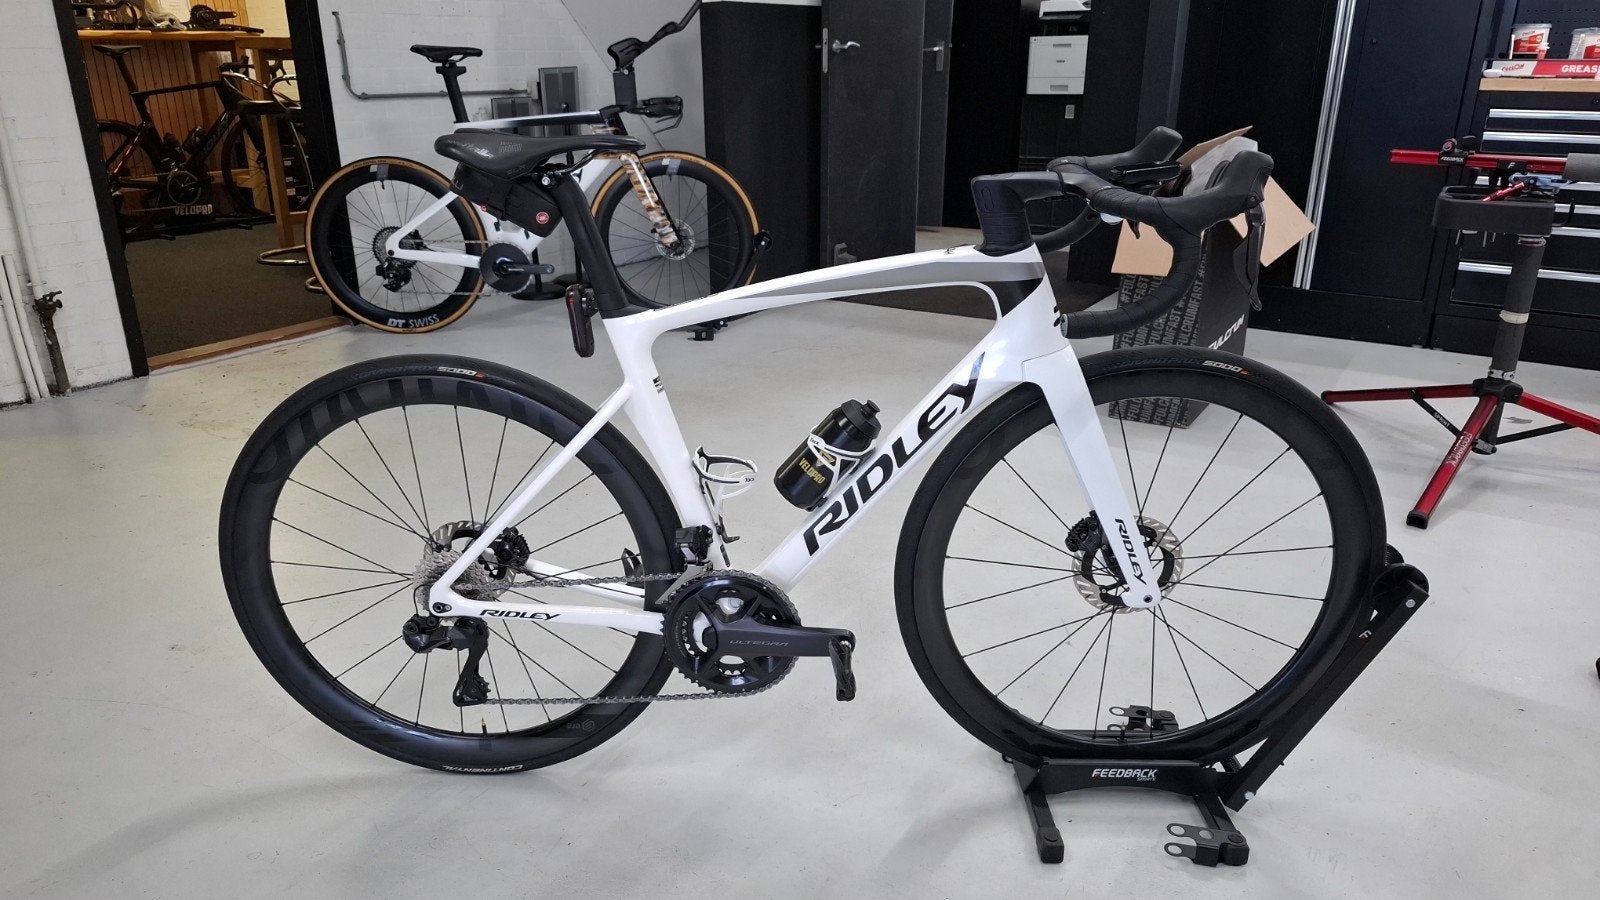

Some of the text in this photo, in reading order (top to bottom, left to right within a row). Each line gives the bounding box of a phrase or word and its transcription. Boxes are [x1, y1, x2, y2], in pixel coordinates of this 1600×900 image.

[1561, 64, 1600, 73] GREAS
[174, 203, 213, 216] VELOPRO
[387, 313, 440, 328] DT SWISS
[437, 366, 477, 376] 5000
[1202, 360, 1243, 373] 5000
[803, 351, 986, 557] RIDLEY
[798, 457, 826, 485] VELOPRO
[1115, 518, 1147, 585] RIDLEY
[480, 609, 561, 621] RIDLEY
[729, 639, 789, 647] ULTEGRA
[441, 764, 523, 773] CONTINENTAL
[1091, 768, 1158, 778] FEEDBACK
